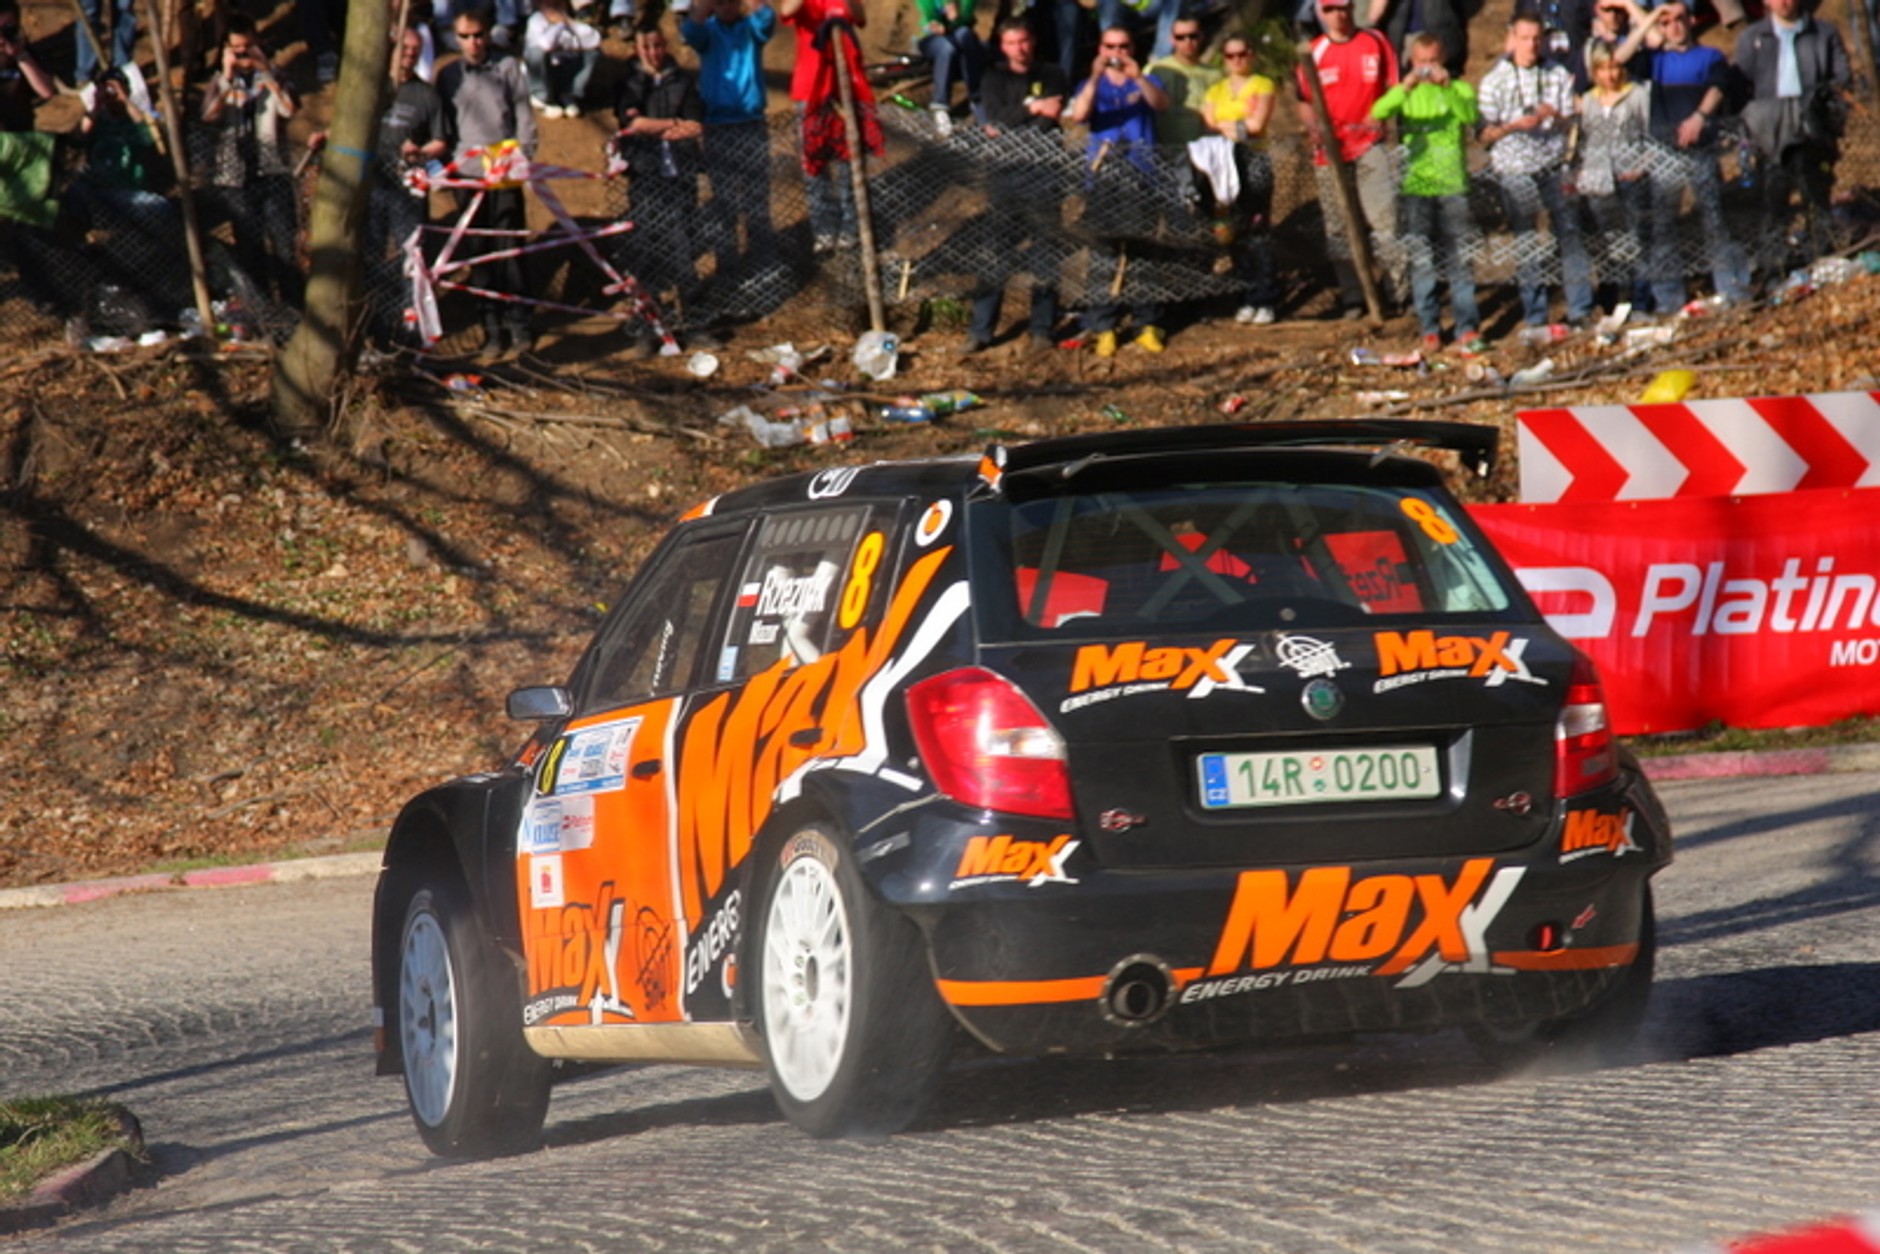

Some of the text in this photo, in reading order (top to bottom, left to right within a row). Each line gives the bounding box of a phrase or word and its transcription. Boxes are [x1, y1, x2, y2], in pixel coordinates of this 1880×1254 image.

[1398, 497, 1460, 545] 8
[838, 531, 885, 630] 8
[1631, 557, 1880, 638] Platin
[1829, 638, 1880, 667] MO
[1238, 752, 1420, 798] 14R 0200
[1180, 964, 1373, 1004] ENERGY DRINK
